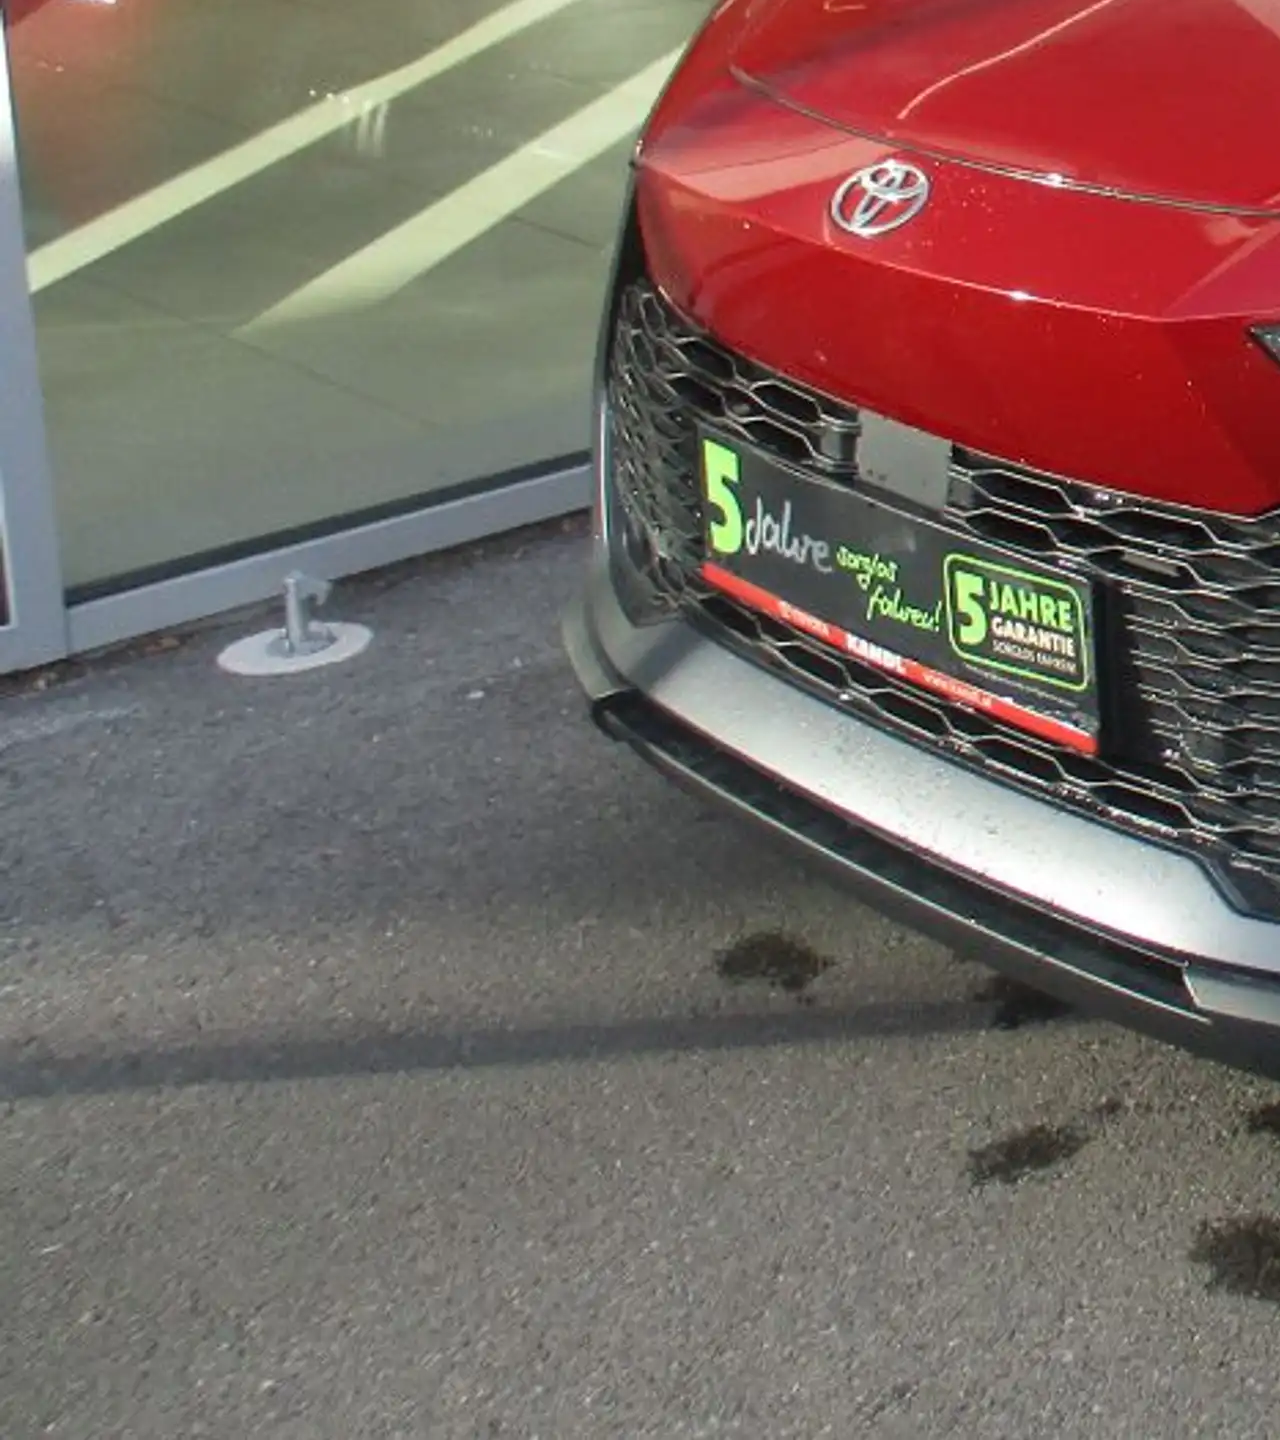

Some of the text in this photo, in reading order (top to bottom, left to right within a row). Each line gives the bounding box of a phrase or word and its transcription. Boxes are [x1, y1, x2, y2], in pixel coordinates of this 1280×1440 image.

[704, 439, 743, 553] 5
[954, 570, 1074, 646] 5 JAHRE
[991, 616, 1077, 658] GARANTIE
